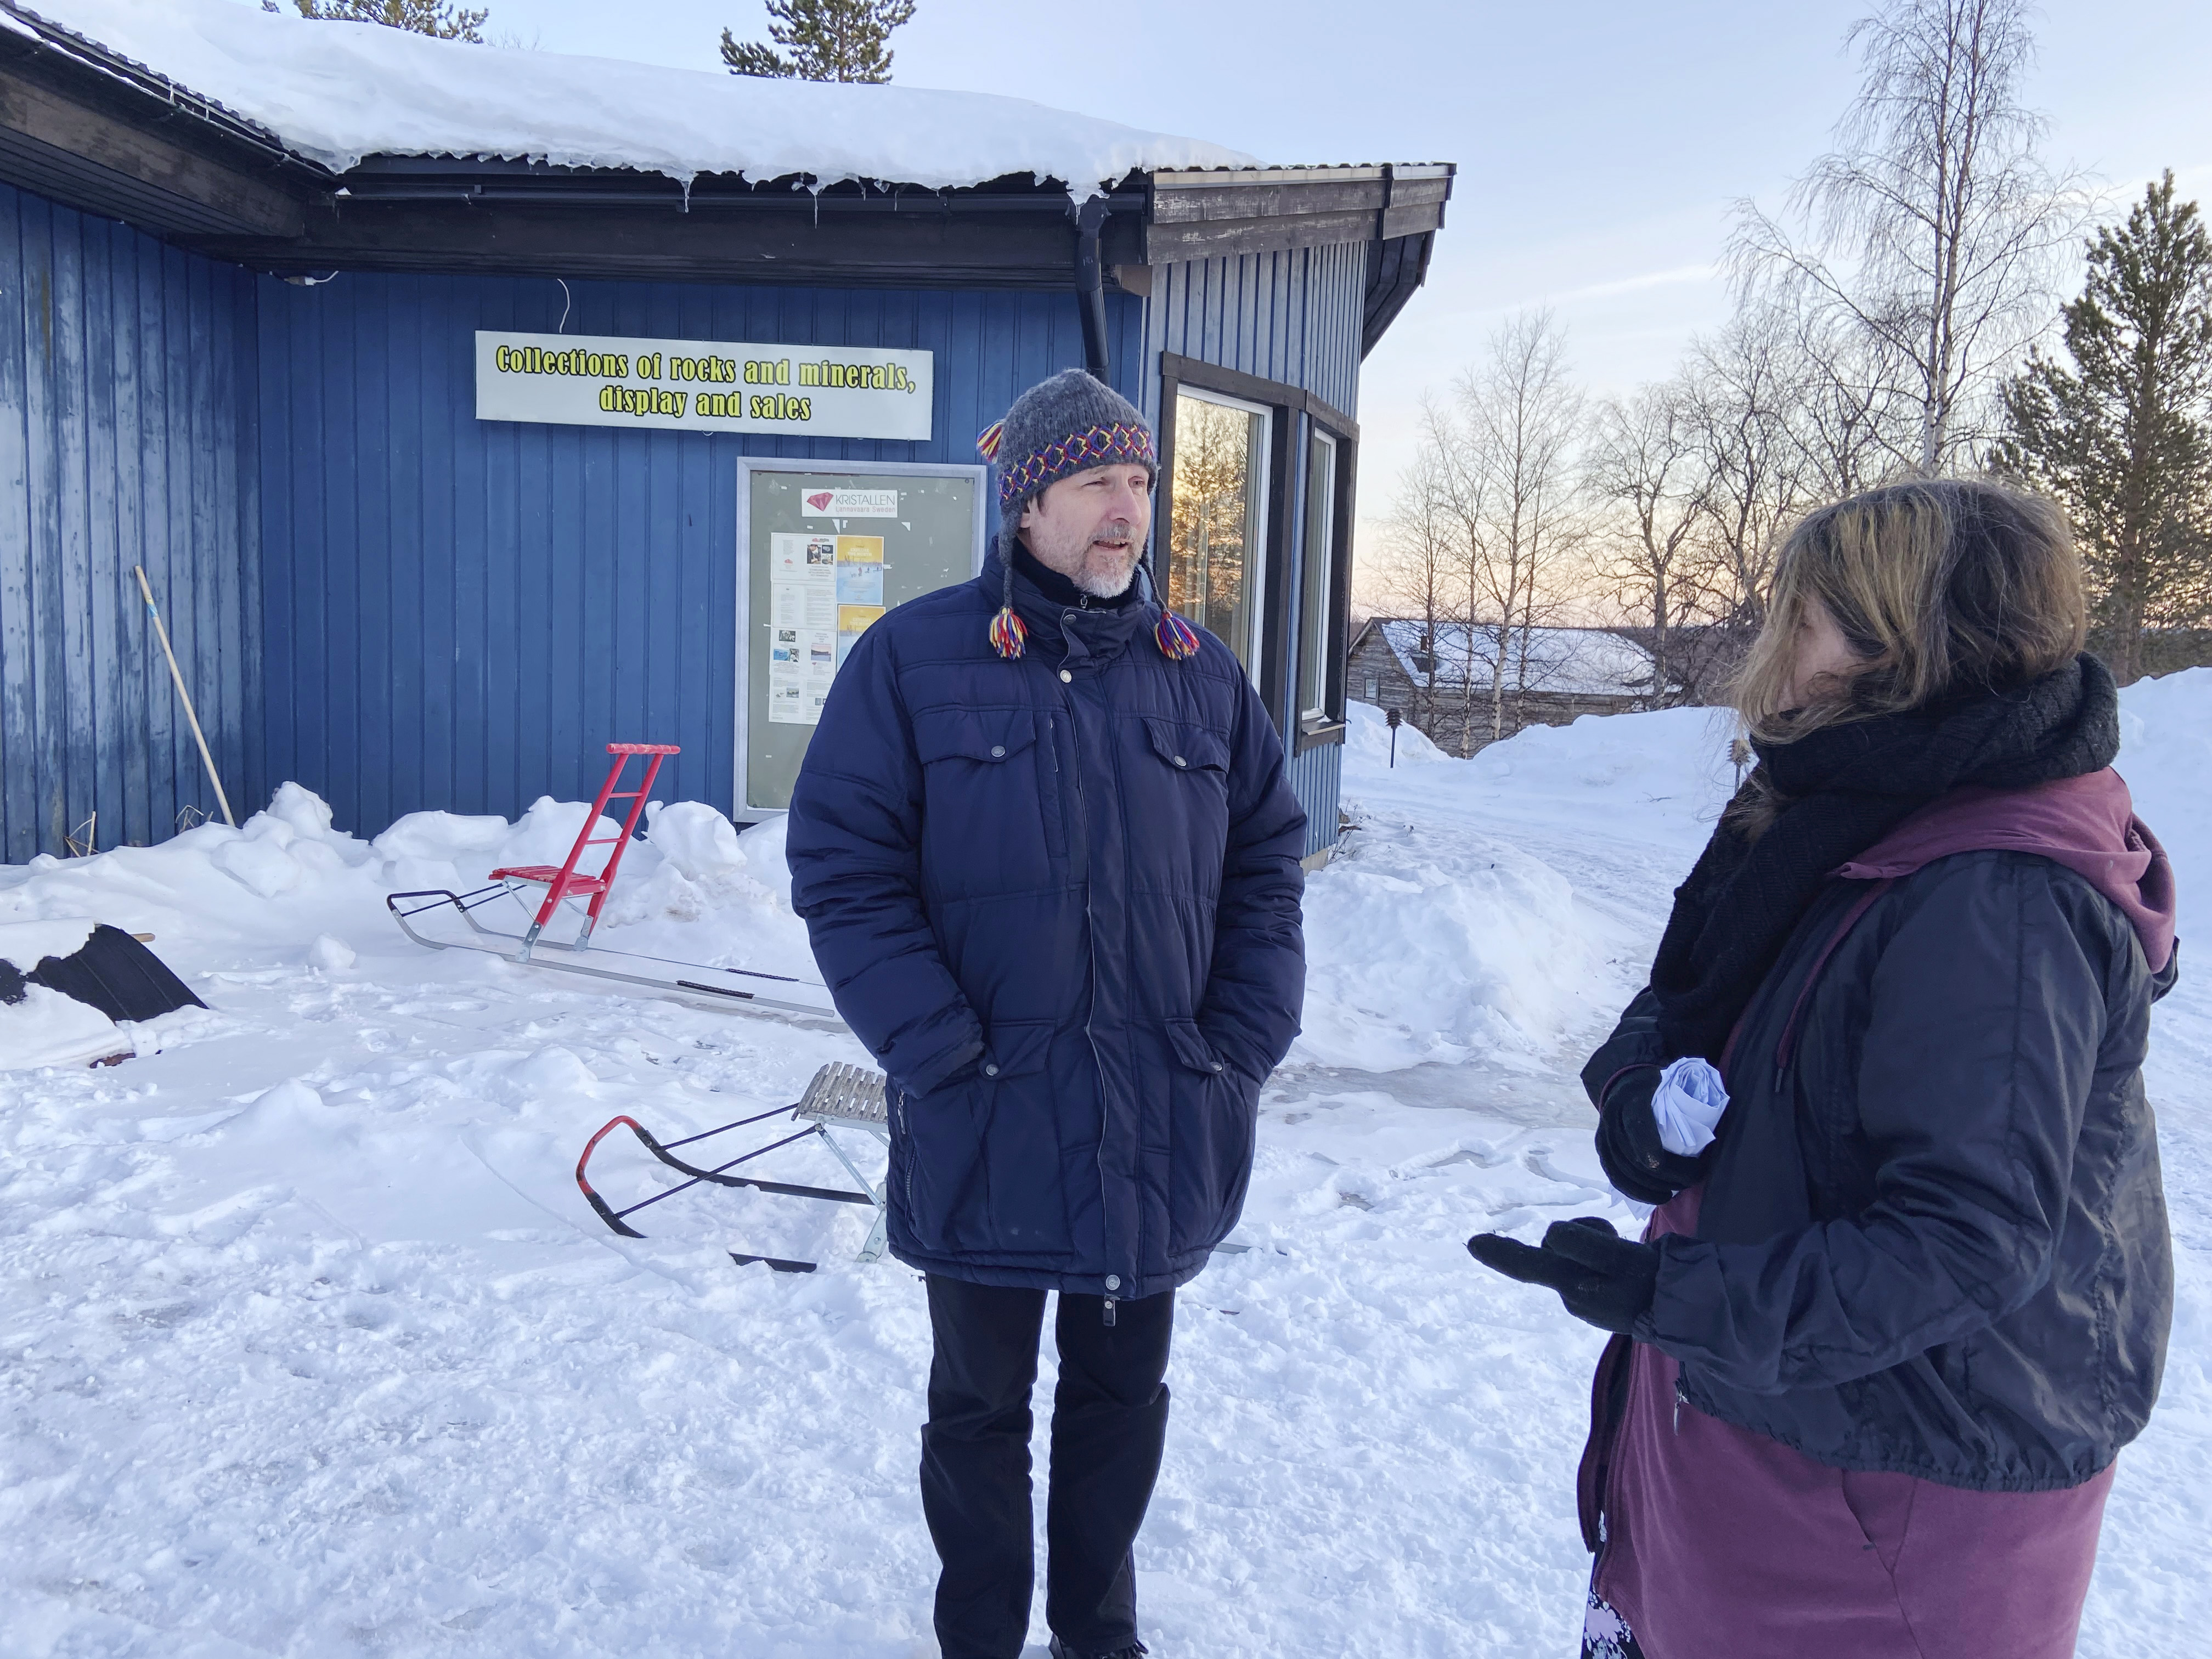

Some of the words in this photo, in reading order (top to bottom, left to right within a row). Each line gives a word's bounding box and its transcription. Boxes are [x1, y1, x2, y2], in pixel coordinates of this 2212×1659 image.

[496, 345, 629, 379] Collections
[636, 352, 662, 380] of
[669, 355, 736, 383] rocks
[743, 359, 790, 386] and
[799, 360, 917, 393] minerals,
[599, 385, 687, 418] display
[695, 391, 742, 418] and
[750, 393, 811, 421] sales
[836, 494, 895, 505] KRISTALLEN
